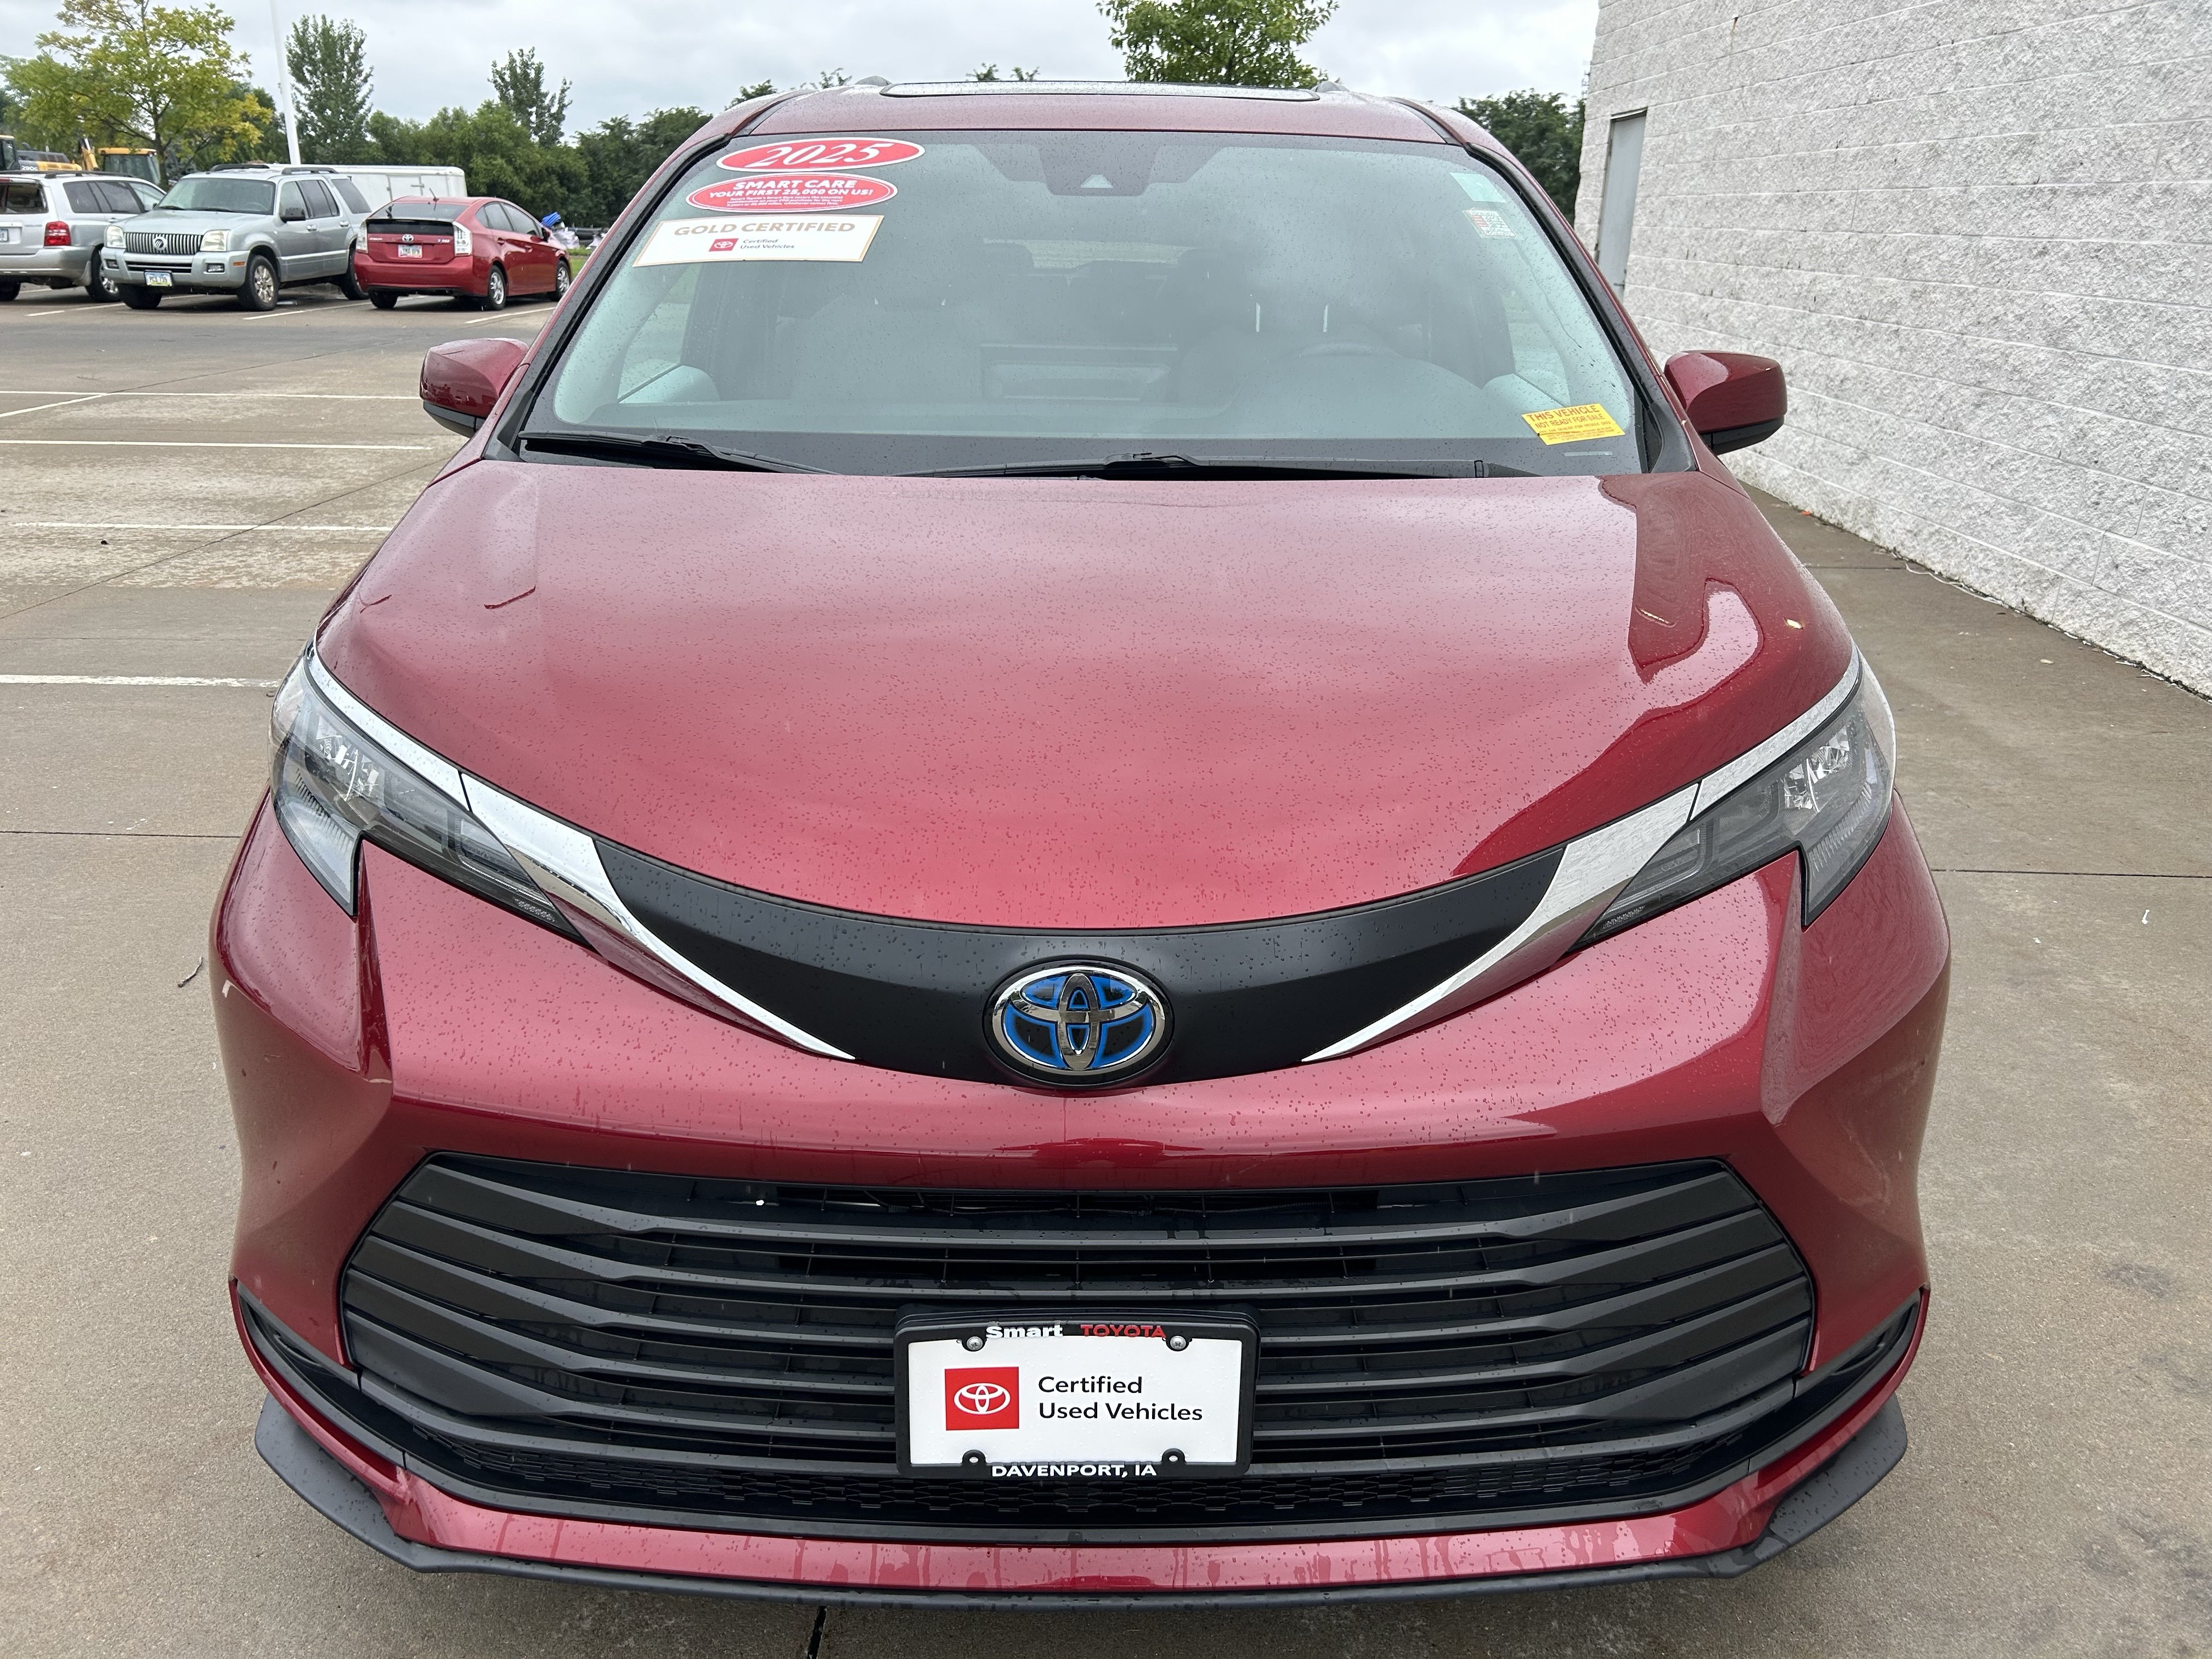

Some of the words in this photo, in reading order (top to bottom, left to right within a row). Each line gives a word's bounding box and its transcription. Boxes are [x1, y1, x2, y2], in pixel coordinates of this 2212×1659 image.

[744, 143, 895, 168] 2025
[733, 180, 803, 190] SMART
[804, 179, 857, 188] CARE
[674, 224, 737, 235] GOLD
[741, 222, 855, 232] CERTIFIED
[1527, 411, 1554, 422] THIS
[1553, 405, 1600, 417] VEHICLE
[1550, 417, 1573, 426] READY
[986, 1323, 1063, 1339] Smart
[1080, 1324, 1166, 1339] TOYOTA
[1038, 1375, 1142, 1394] Certified
[1039, 1402, 1098, 1420] Used
[1105, 1403, 1203, 1421] Vehicles
[991, 1464, 1128, 1479] DAVENPORT,
[1135, 1464, 1157, 1476] IA
